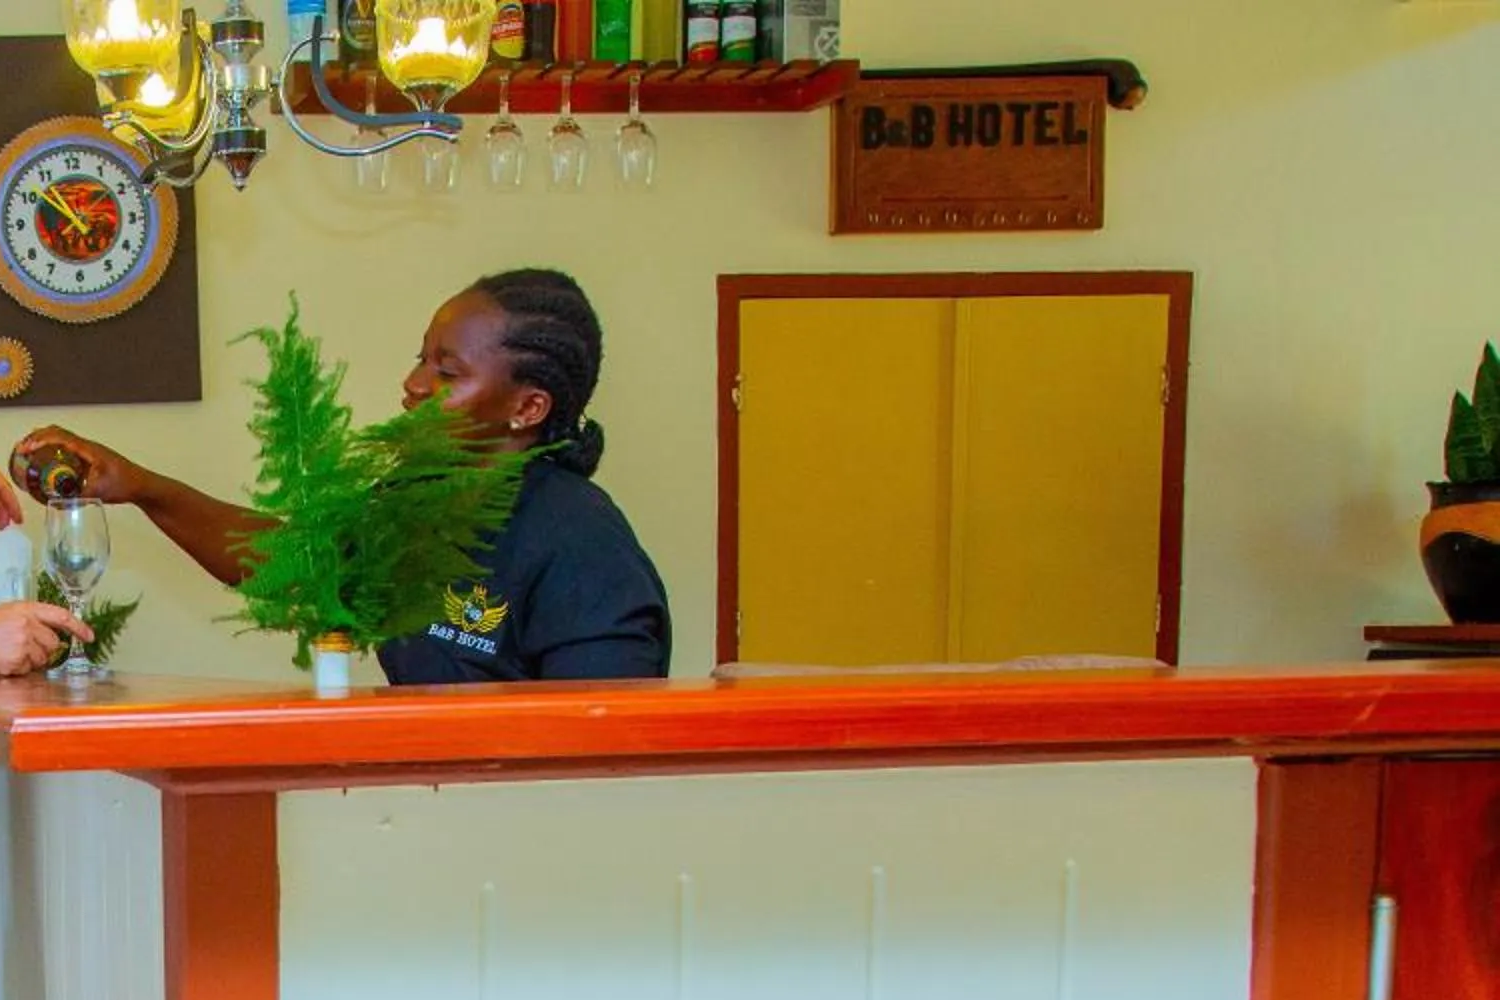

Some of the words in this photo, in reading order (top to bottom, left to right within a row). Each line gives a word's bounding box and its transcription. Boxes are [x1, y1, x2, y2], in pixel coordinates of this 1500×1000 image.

[946, 102, 1088, 147] HOTEL
[64, 157, 80, 170] 12
[39, 170, 52, 182] 11
[117, 182, 126, 195] 2
[22, 191, 37, 204] 10
[128, 211, 137, 225] 3
[16, 219, 25, 231] 9
[122, 239, 131, 251] 4
[28, 247, 37, 260] 8
[47, 263, 56, 275] 7
[104, 259, 113, 271] 5
[76, 270, 85, 282] 6
[456, 631, 497, 655] HOTEL
